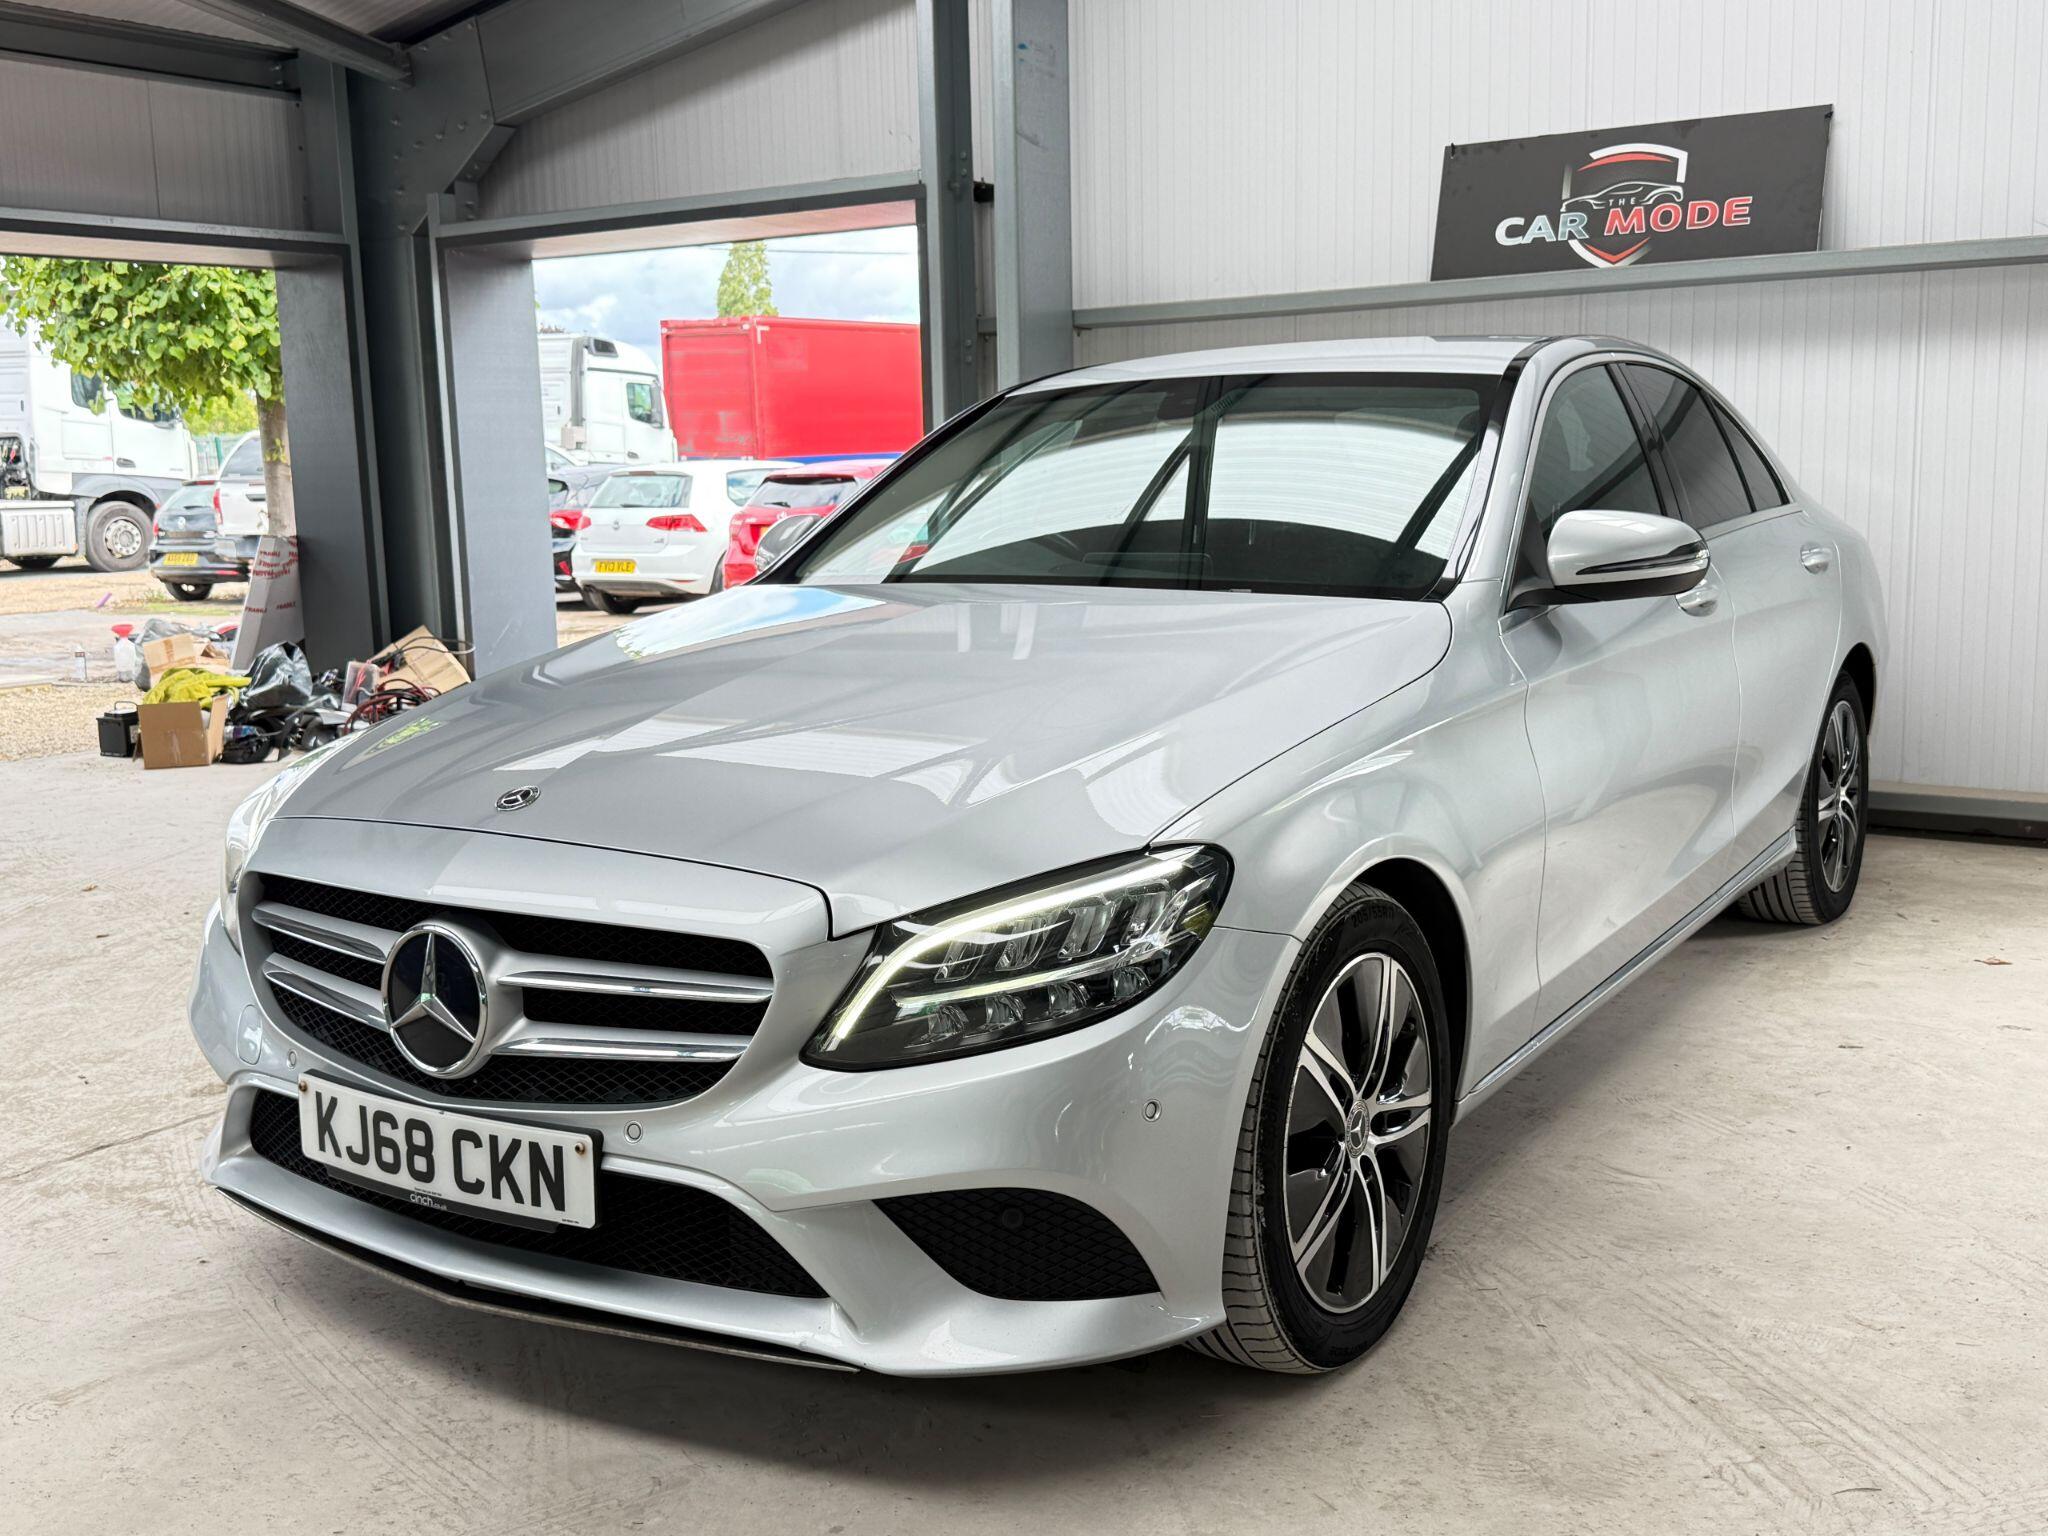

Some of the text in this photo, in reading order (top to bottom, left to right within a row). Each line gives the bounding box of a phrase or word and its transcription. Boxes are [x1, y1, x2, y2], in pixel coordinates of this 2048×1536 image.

[1495, 196, 1753, 246] CAR MODE
[1608, 196, 1636, 207] THE
[315, 1091, 566, 1213] KJ68 CKN
